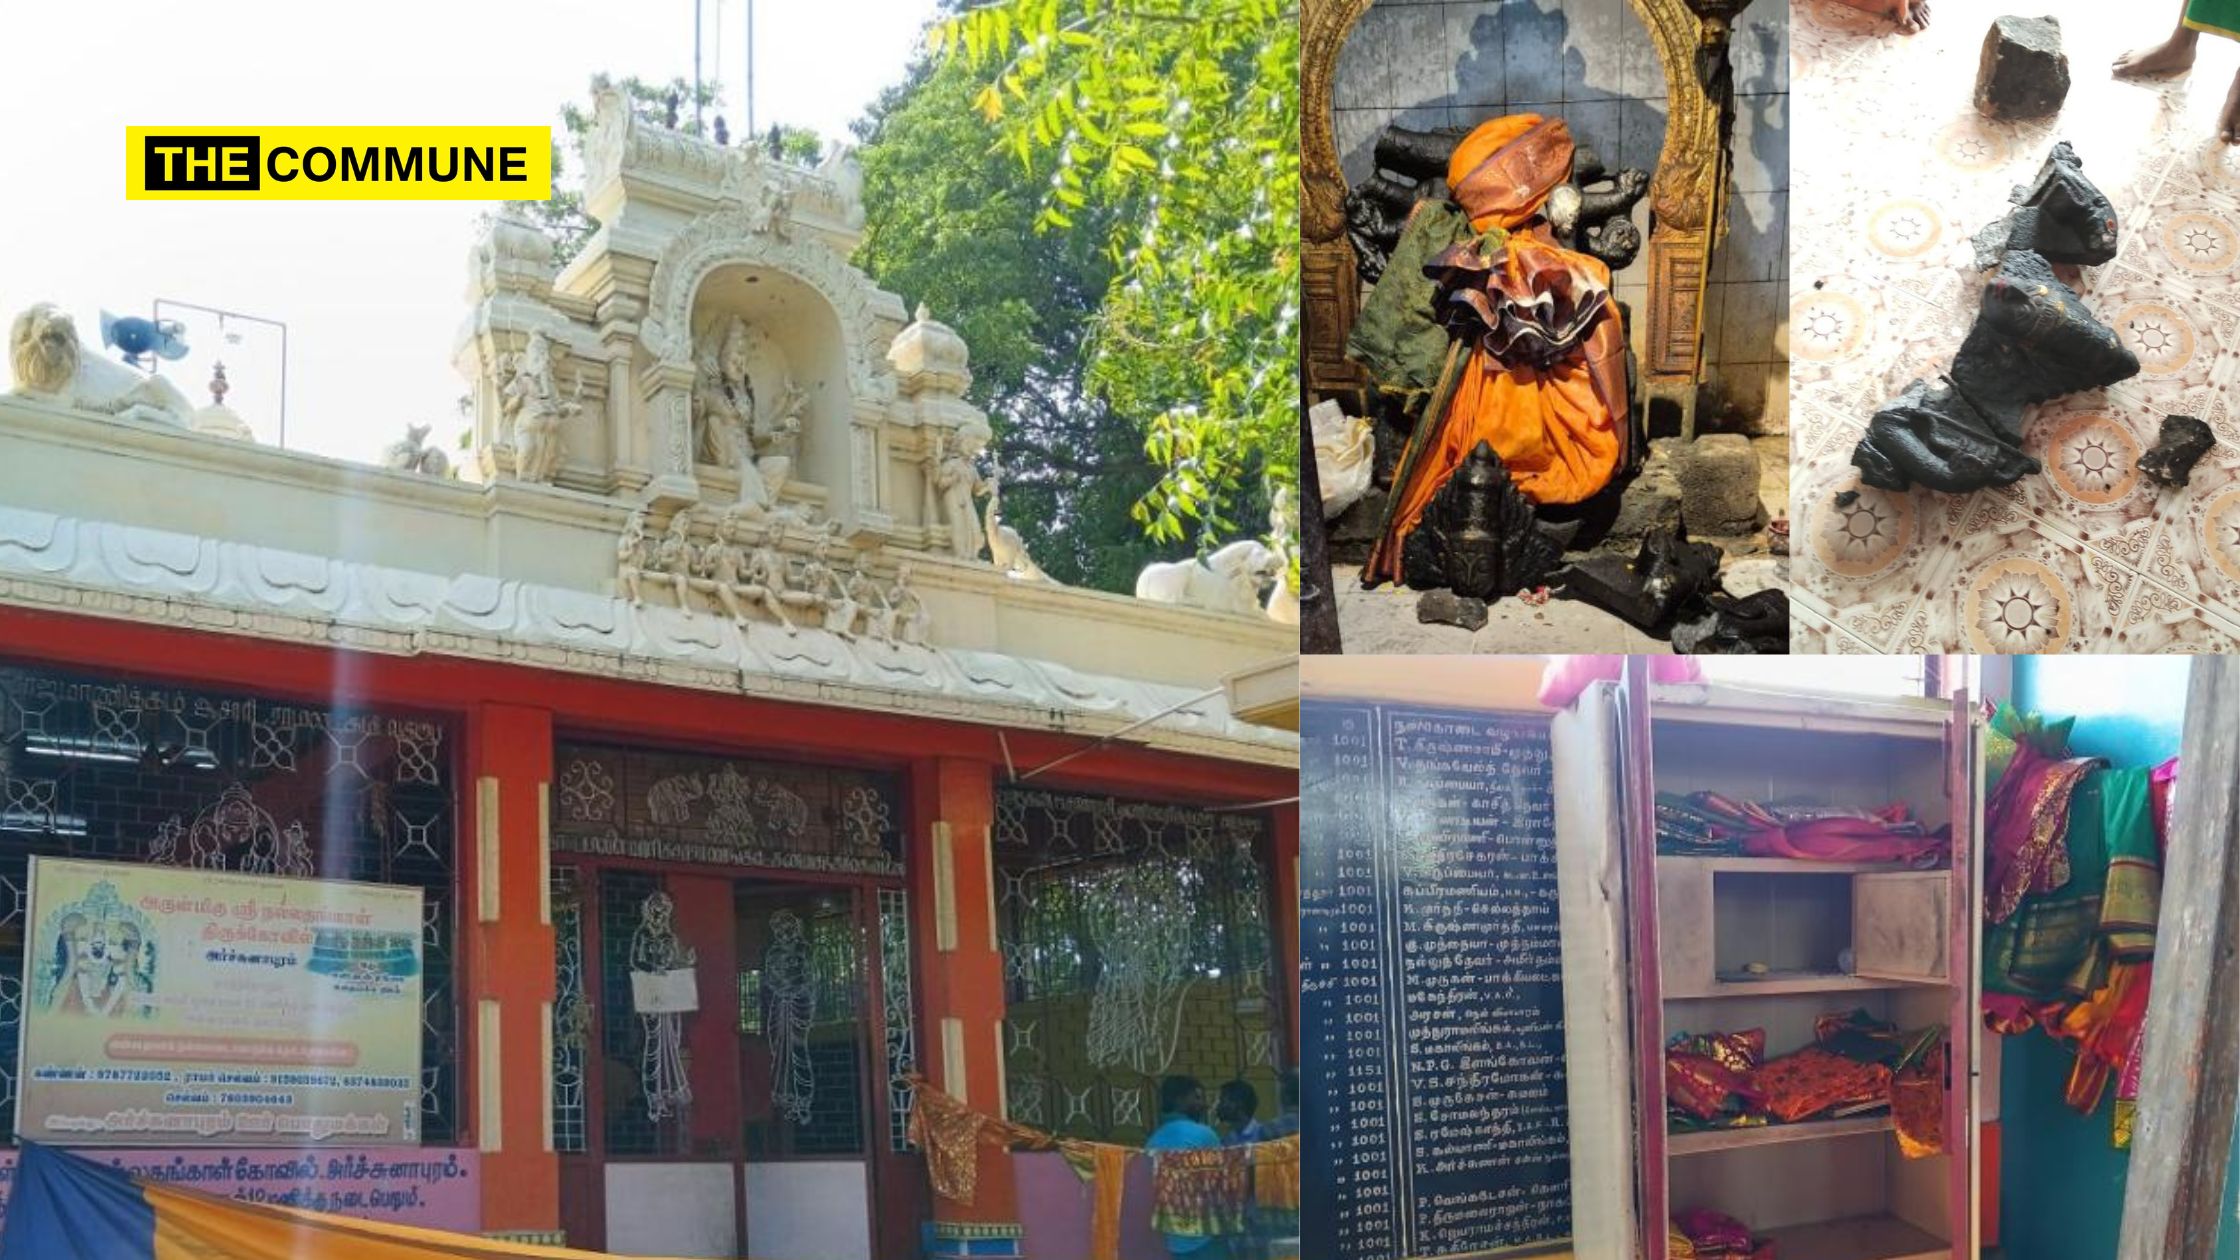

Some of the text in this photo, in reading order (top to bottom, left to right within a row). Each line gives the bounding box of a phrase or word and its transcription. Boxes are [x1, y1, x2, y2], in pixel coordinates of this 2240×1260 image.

[1339, 884, 1375, 899] 1001
[1340, 902, 1374, 915] 1001
[1340, 921, 1376, 934] 1001
[1342, 938, 1377, 952] 1001
[1342, 957, 1378, 970] 1001
[1343, 975, 1378, 988] 1001
[1345, 993, 1380, 1006] 1001
[1346, 1011, 1380, 1025] 1001
[1347, 1029, 1381, 1042] 1001
[1348, 1046, 1382, 1060] 1001
[1348, 1065, 1384, 1077] 1151
[1349, 1081, 1385, 1095] 1001
[1350, 1099, 1385, 1113] 1001
[1351, 1116, 1386, 1130] 1001
[1352, 1132, 1387, 1148] 1001
[1353, 1149, 1388, 1165] 1001
[1354, 1168, 1389, 1183] 1001
[1355, 1184, 1390, 1199] 1001
[1356, 1202, 1391, 1217] 1001
[1357, 1219, 1391, 1234] 1001
[1358, 1236, 1392, 1251] 1001
